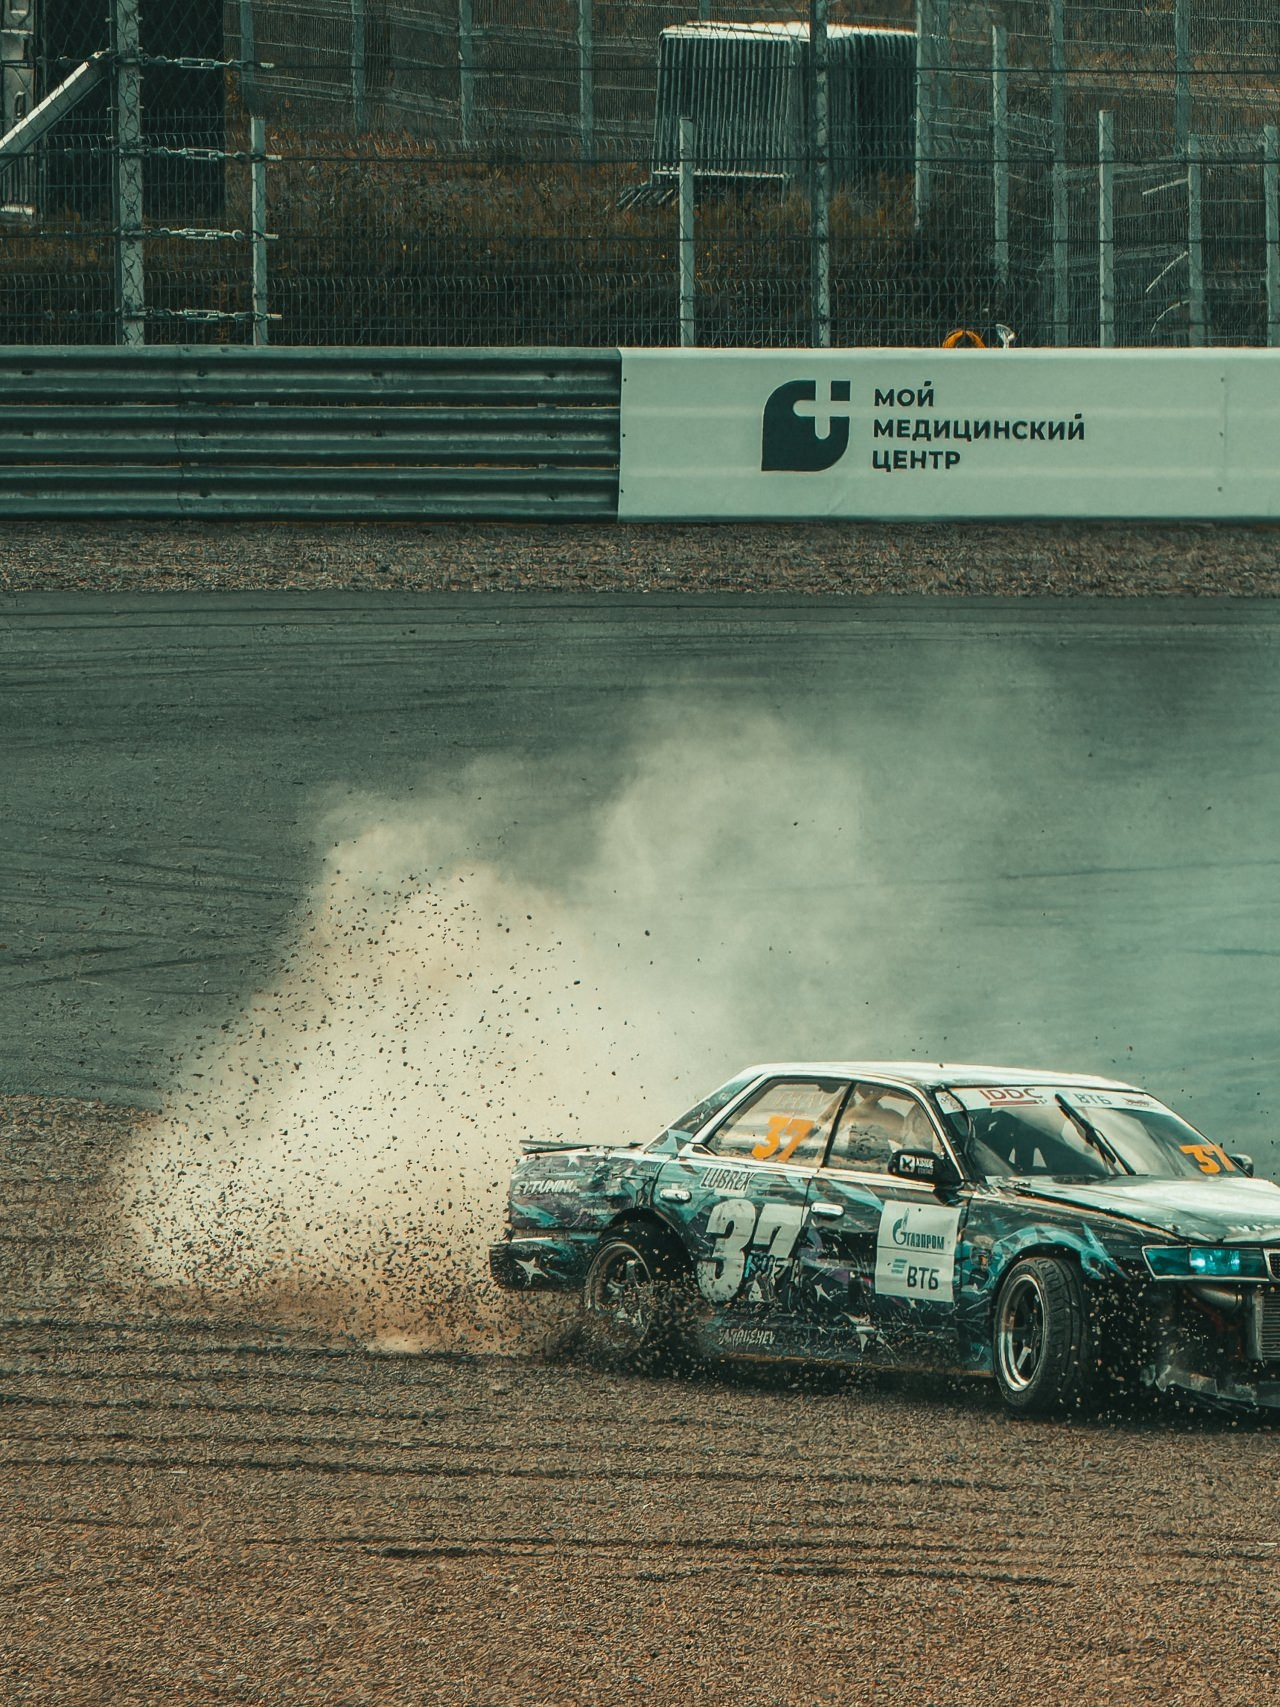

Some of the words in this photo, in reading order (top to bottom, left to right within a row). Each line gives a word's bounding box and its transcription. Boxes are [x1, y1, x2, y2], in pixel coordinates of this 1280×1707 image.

[874, 380, 935, 408] МОЙ
[873, 412, 1085, 442] МЕДИЦИНСКИЙ
[872, 450, 961, 473] ЦЕНТР
[978, 1087, 1043, 1100] IDDC
[751, 1115, 815, 1163] 37
[1178, 1144, 1237, 1174] 37
[701, 1167, 754, 1191] LUBREX
[696, 1199, 810, 1302] 37
[906, 1232, 945, 1250] ГАЗПРОМ
[906, 1265, 941, 1291] ВТБ
